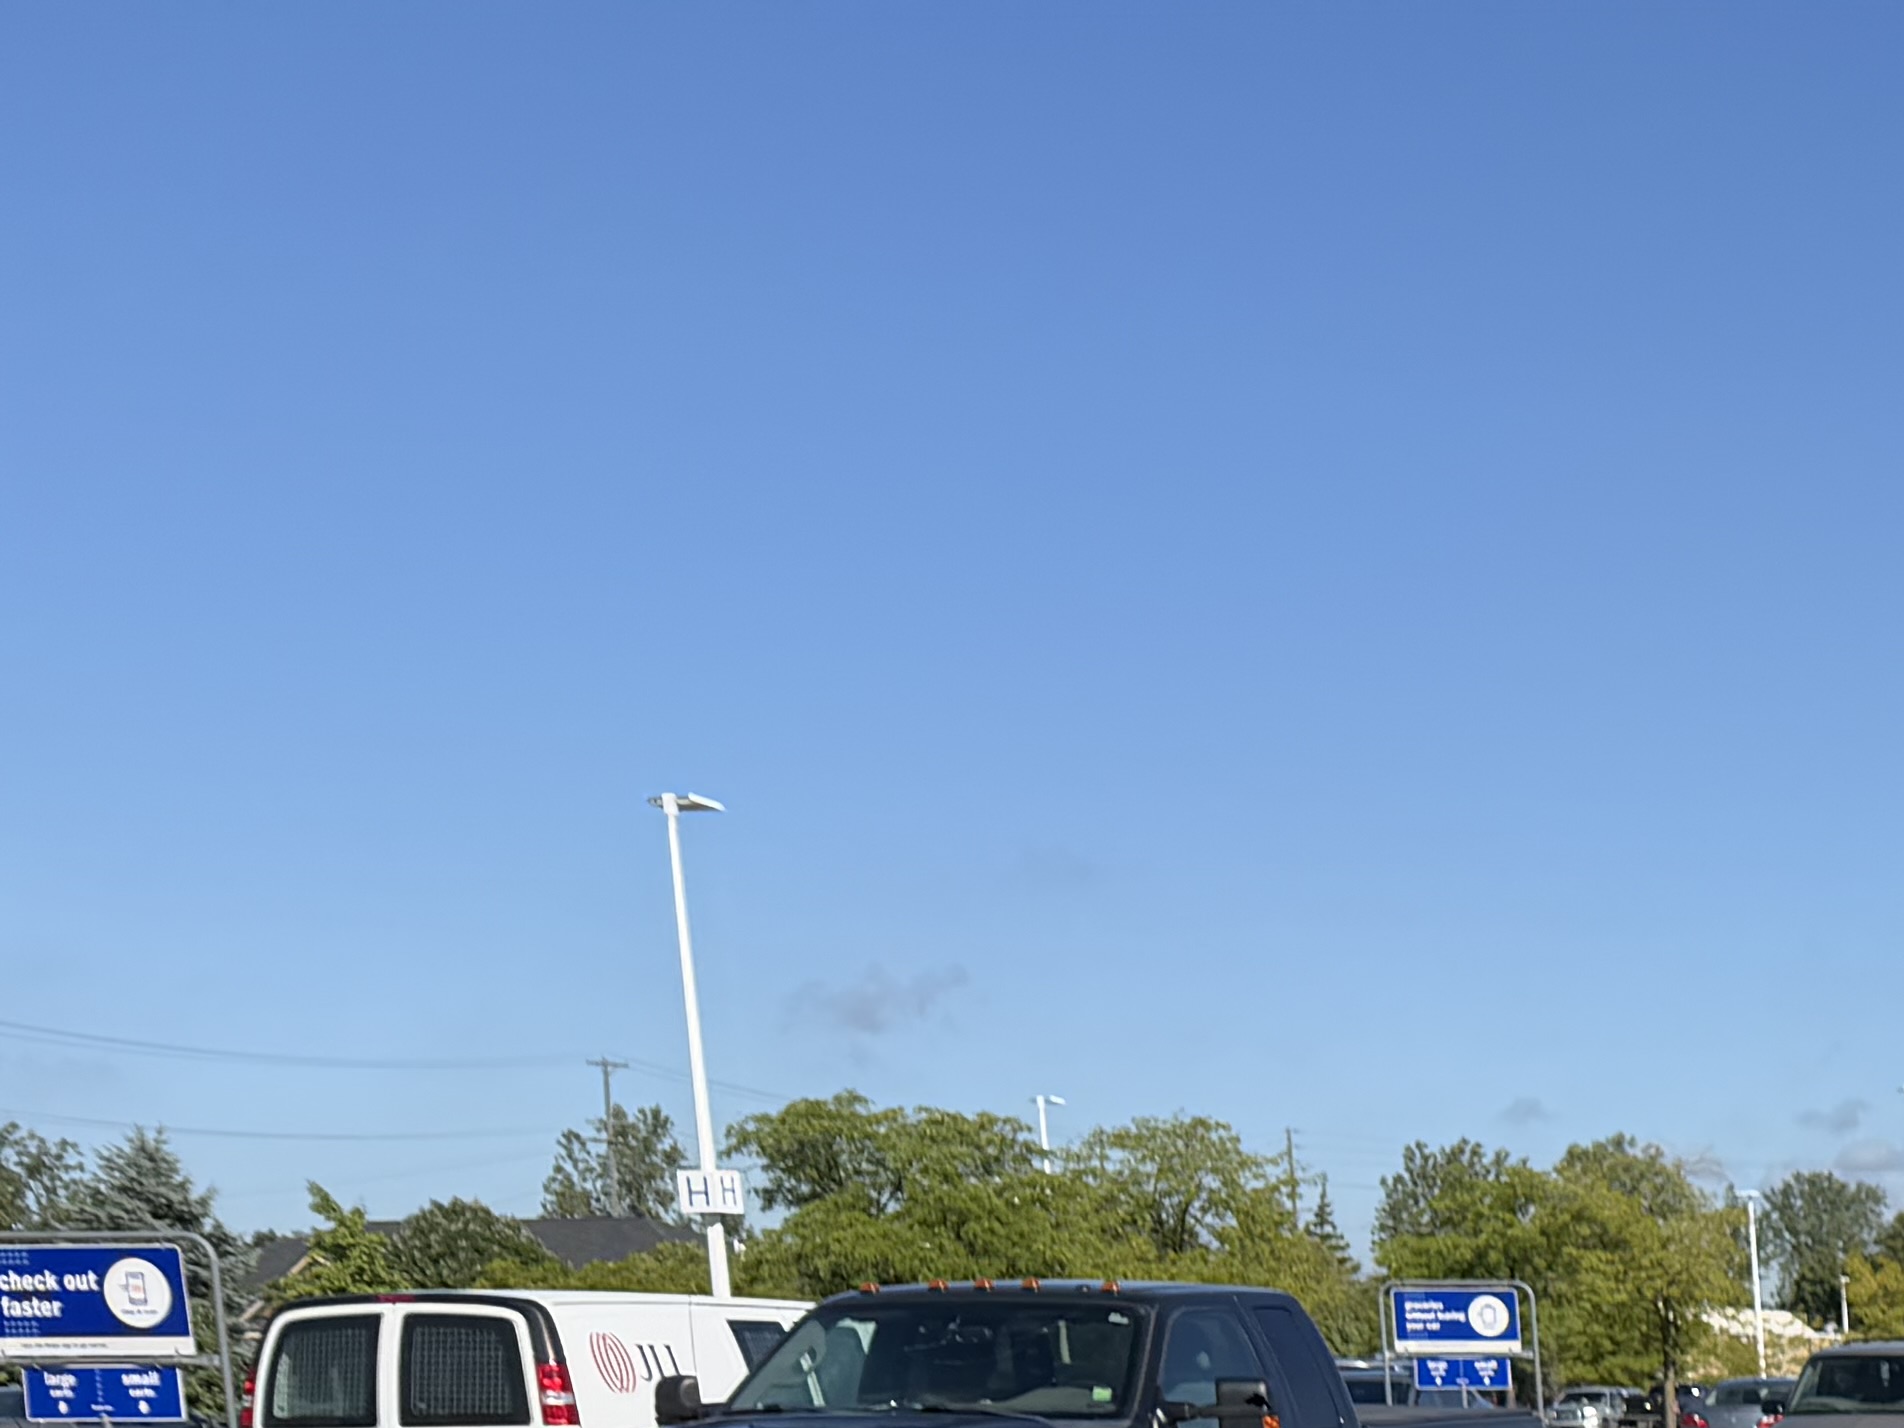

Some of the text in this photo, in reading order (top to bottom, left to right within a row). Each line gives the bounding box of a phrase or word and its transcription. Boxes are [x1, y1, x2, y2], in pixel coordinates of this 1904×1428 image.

[686, 1176, 710, 1207] H
[720, 1175, 737, 1206] H
[0, 1269, 100, 1292] check out
[1, 1296, 64, 1318] faster
